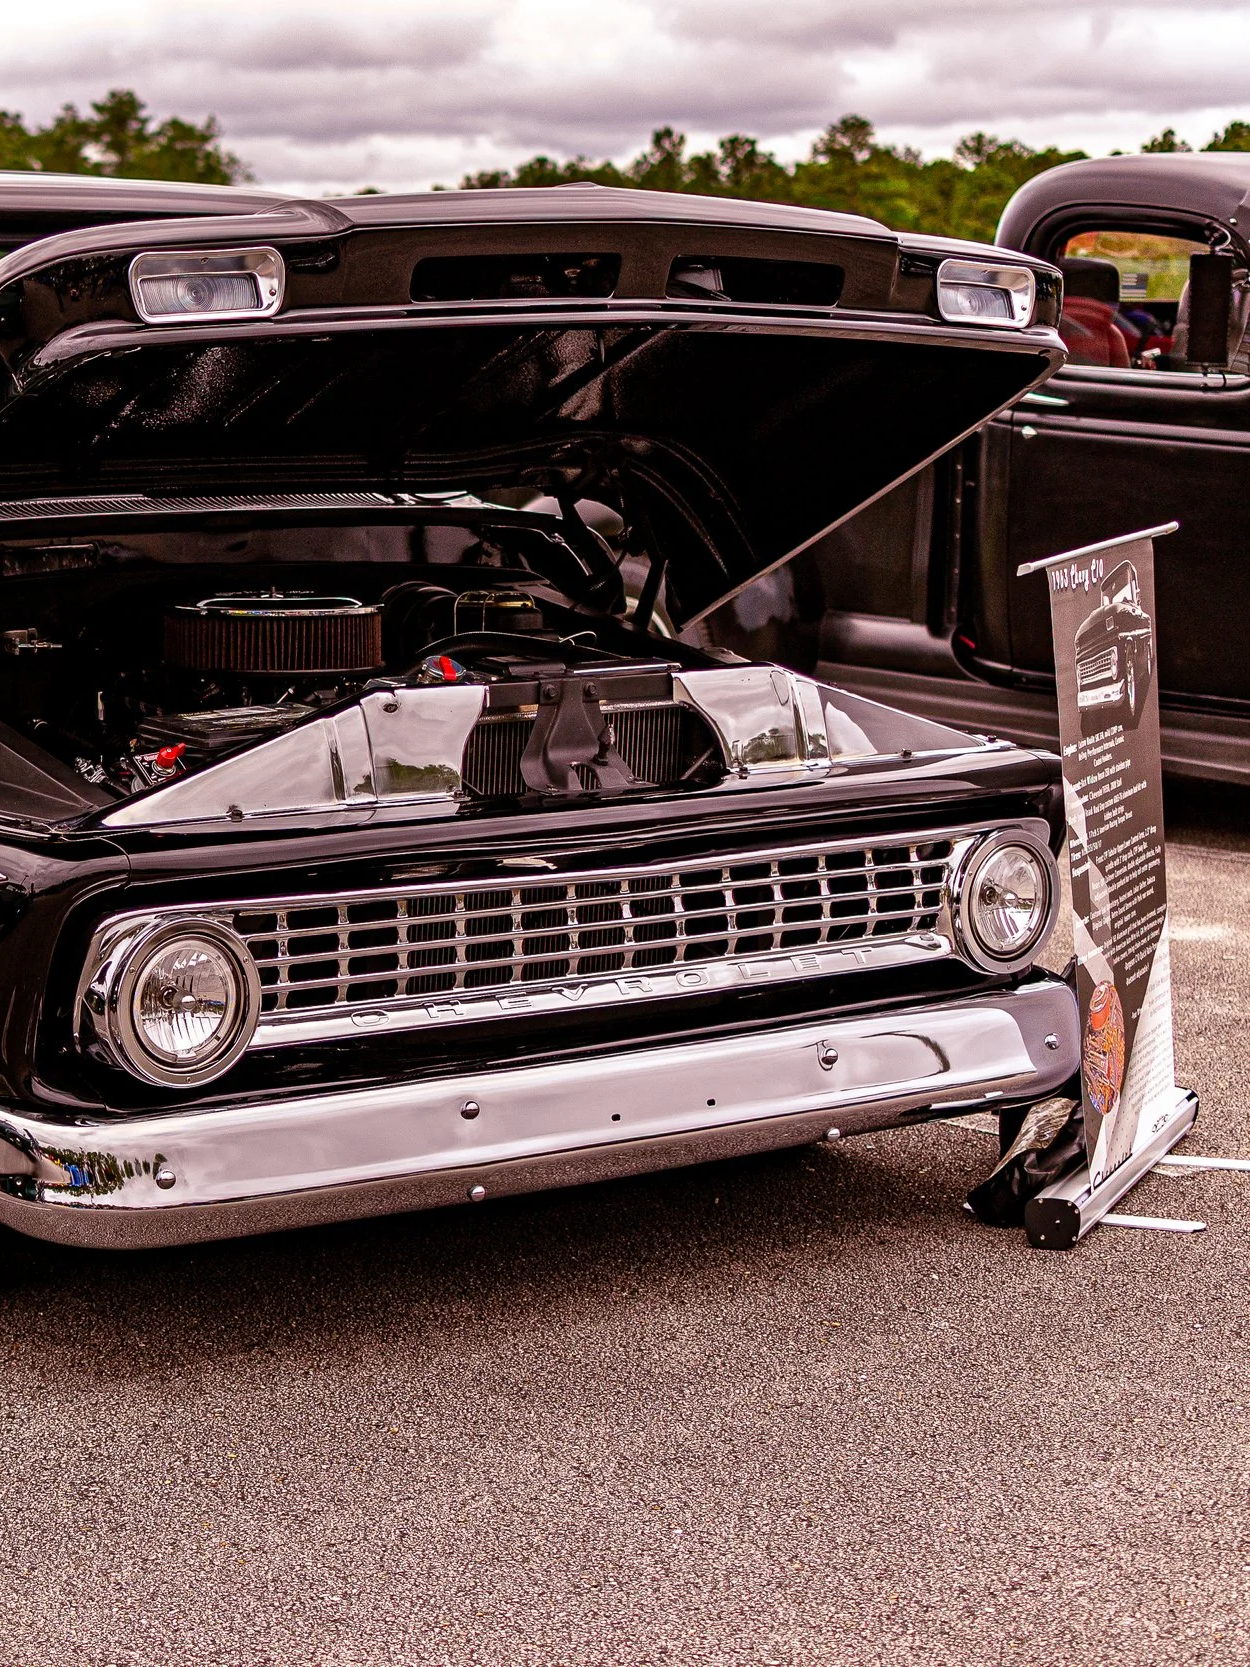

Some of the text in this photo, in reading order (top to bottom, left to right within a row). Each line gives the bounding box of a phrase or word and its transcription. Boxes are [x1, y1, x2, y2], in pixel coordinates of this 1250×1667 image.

[1051, 558, 1104, 592] 1963 Chevy C10
[349, 945, 876, 1029] CHEVROLET
